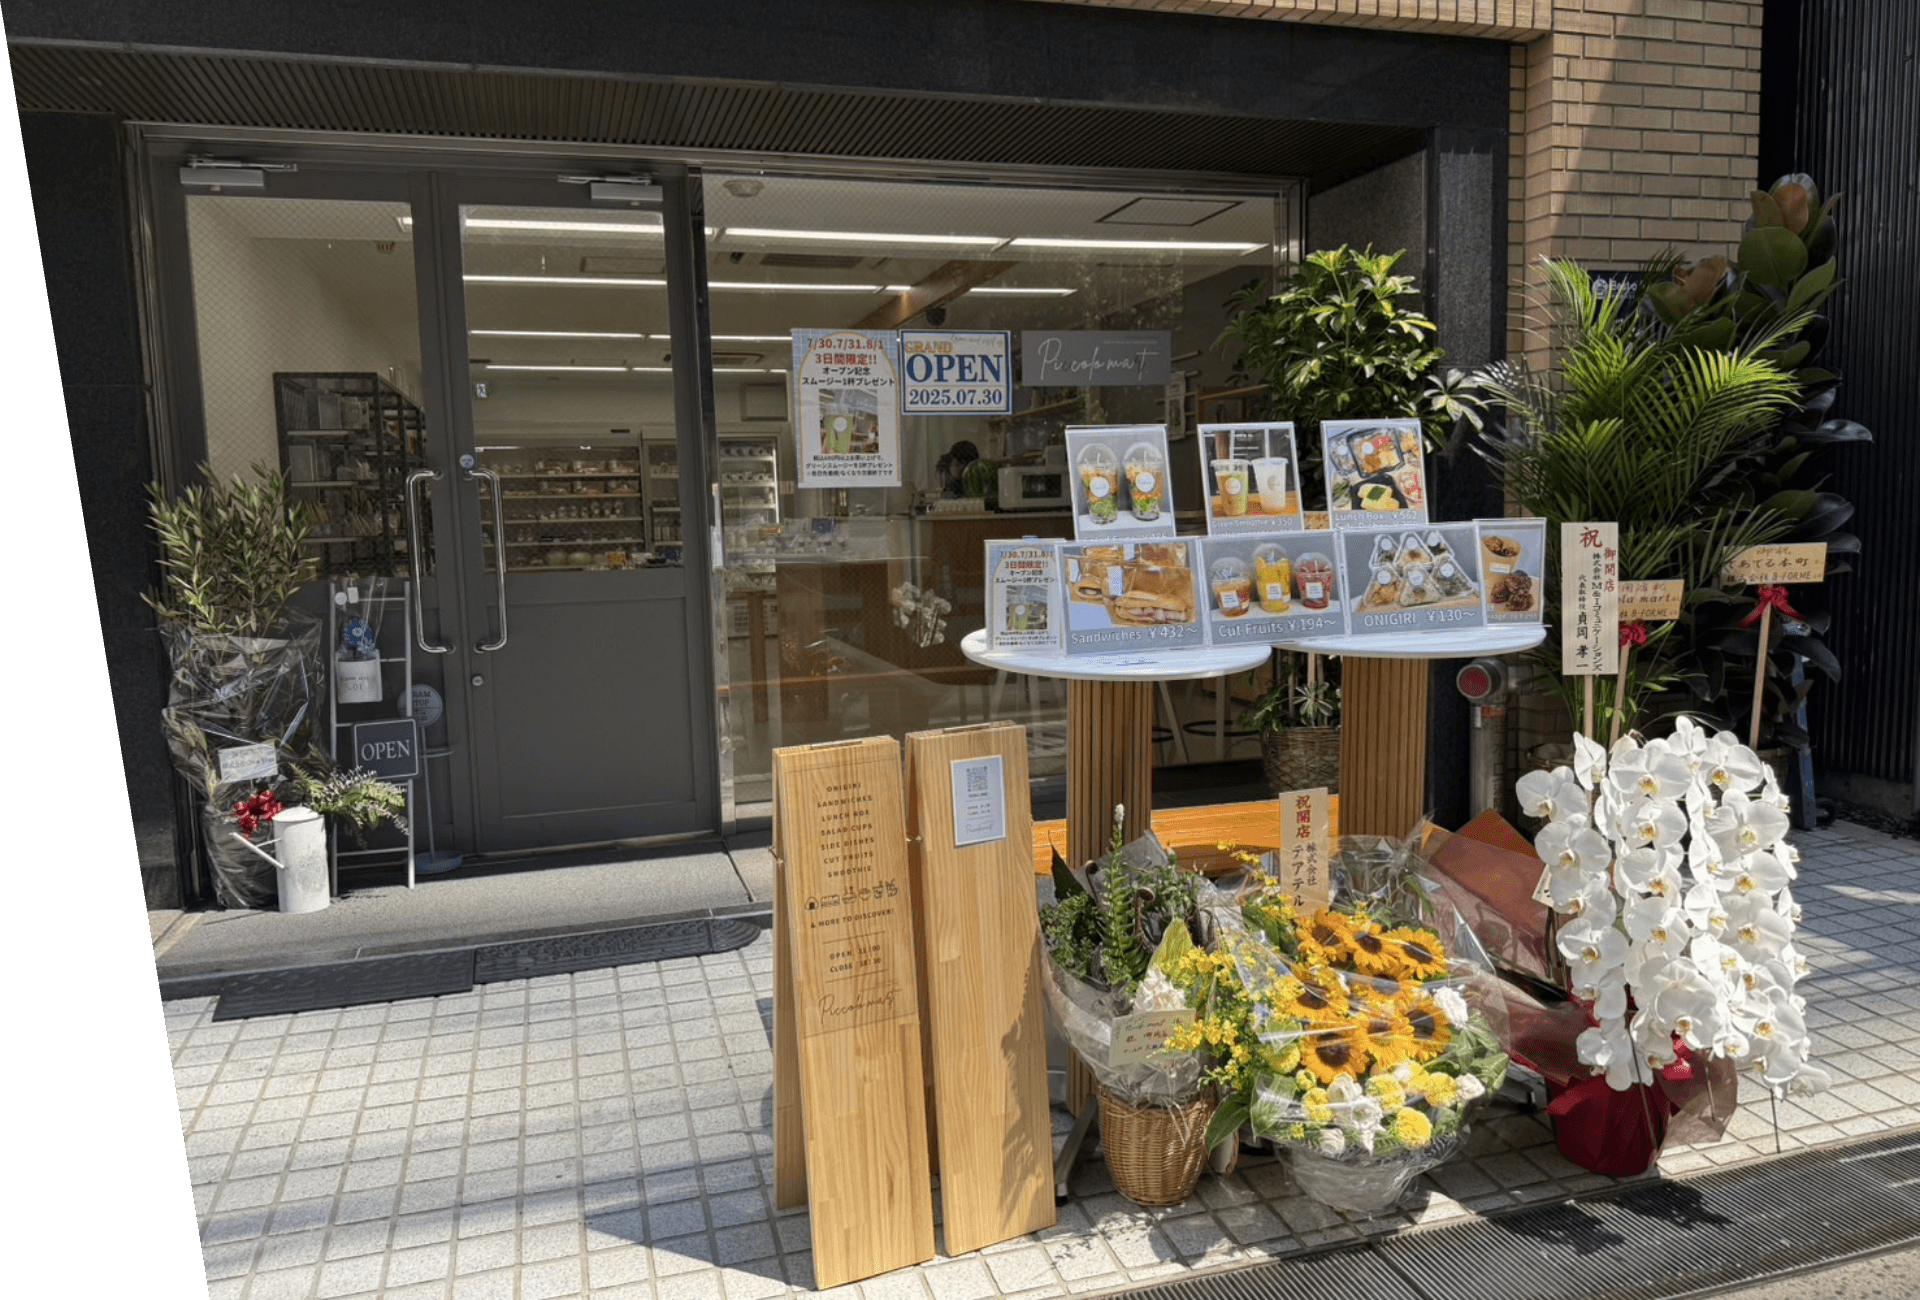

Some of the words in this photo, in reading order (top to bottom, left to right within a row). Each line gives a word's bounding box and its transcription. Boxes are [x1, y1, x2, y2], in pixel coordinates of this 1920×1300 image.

[807, 338, 884, 351] 7/30.7/31.8/1
[905, 341, 954, 353] GRAND
[822, 366, 871, 375] オープン記念
[907, 354, 1003, 382] OPEN
[802, 376, 895, 386] スムージー1杯プレゼント
[909, 389, 1002, 405] 2025.07.30
[1335, 512, 1364, 521] Lunch
[1366, 512, 1383, 520] Box
[1579, 526, 1603, 548] 祝
[1603, 547, 1616, 592] 御開店
[1639, 593, 1670, 603] mart
[1364, 612, 1417, 626] ONIGIRI
[1219, 625, 1242, 637] Cut
[1245, 621, 1284, 634] Fruits
[1071, 630, 1142, 644] Sandwiches
[360, 739, 411, 762] OPEN
[826, 782, 861, 792] ONIGIRI
[817, 795, 873, 808] SANDWICHES
[822, 812, 850, 822] LUNCH
[1295, 794, 1311, 839] 祝開店
[821, 827, 848, 837] SALAD
[851, 823, 873, 832] CUPS
[821, 842, 840, 850] SIDE
[844, 837, 874, 847] DISHES
[824, 856, 840, 864] CUT
[843, 851, 874, 861] FRUITS
[1306, 841, 1318, 887] 株式会社
[827, 865, 872, 878] SMOOTHIE
[1291, 844, 1305, 907] テアテル
[818, 918, 840, 927] MORE
[854, 908, 894, 920] DISCOVER!
[829, 949, 852, 960] OPEN
[830, 962, 853, 973] CLOSE
